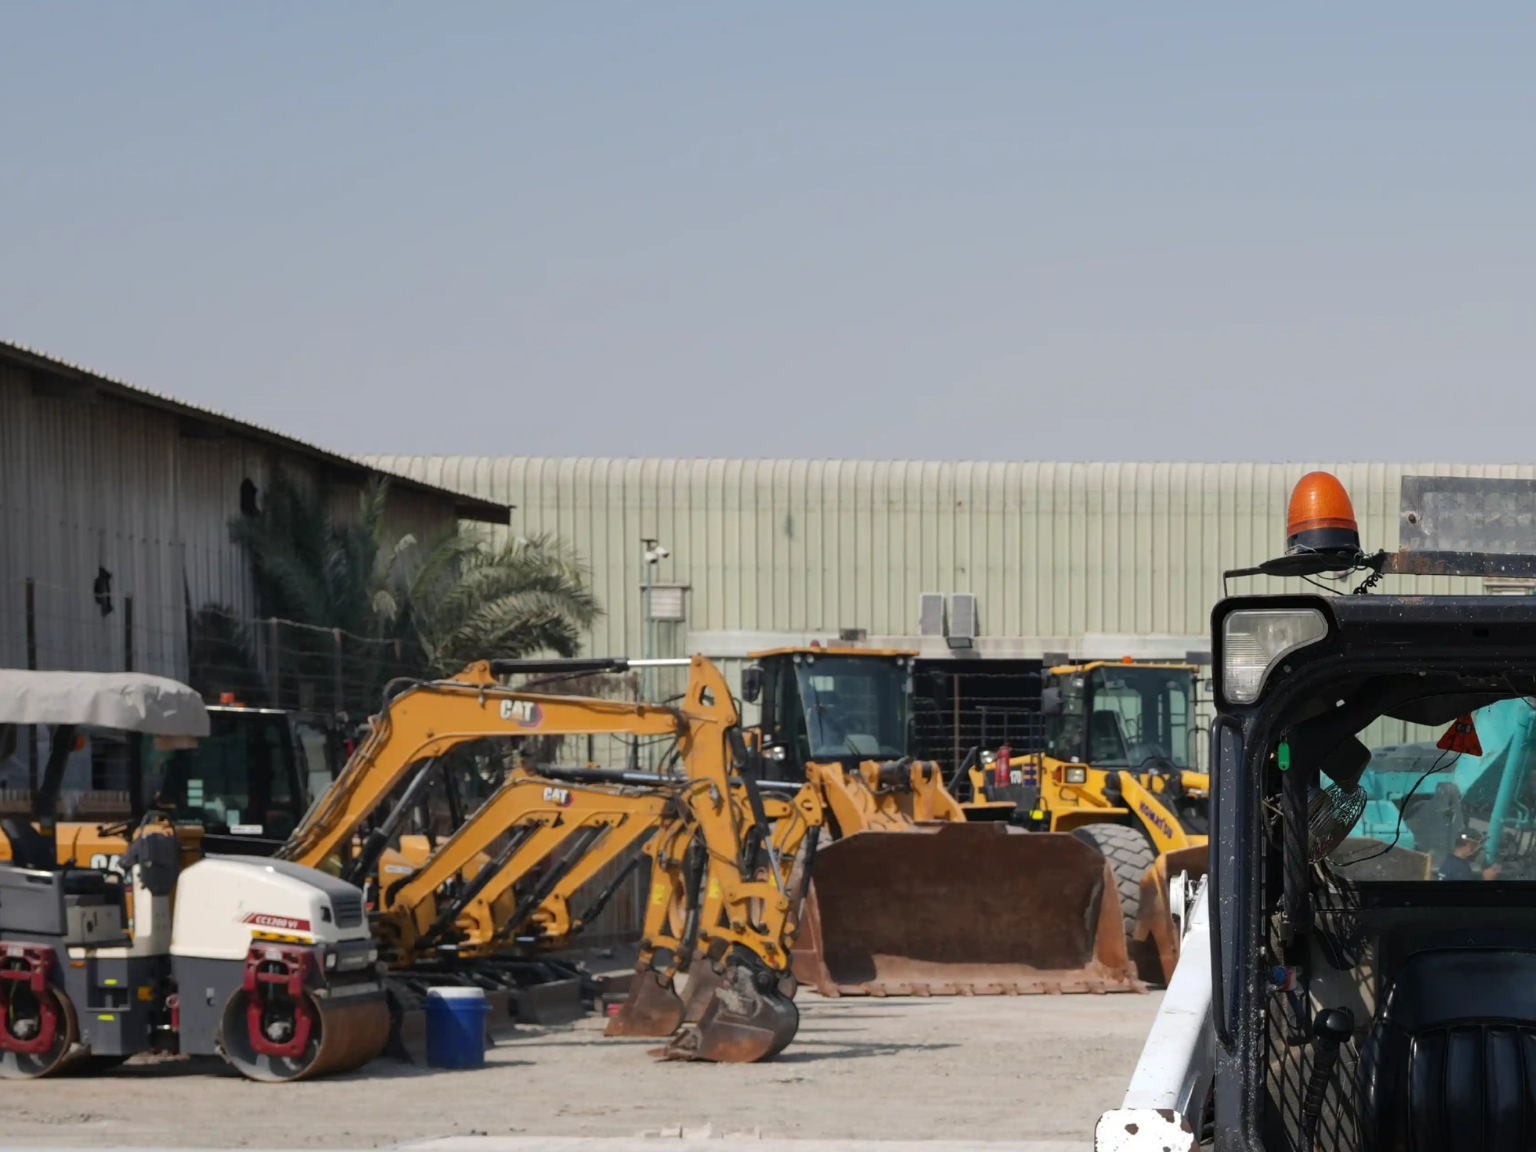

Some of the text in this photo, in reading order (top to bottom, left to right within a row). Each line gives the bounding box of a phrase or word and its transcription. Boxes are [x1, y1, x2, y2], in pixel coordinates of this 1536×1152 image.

[500, 699, 535, 722] CAT
[543, 787, 569, 804] CAT
[1140, 800, 1173, 839] KOMATSU
